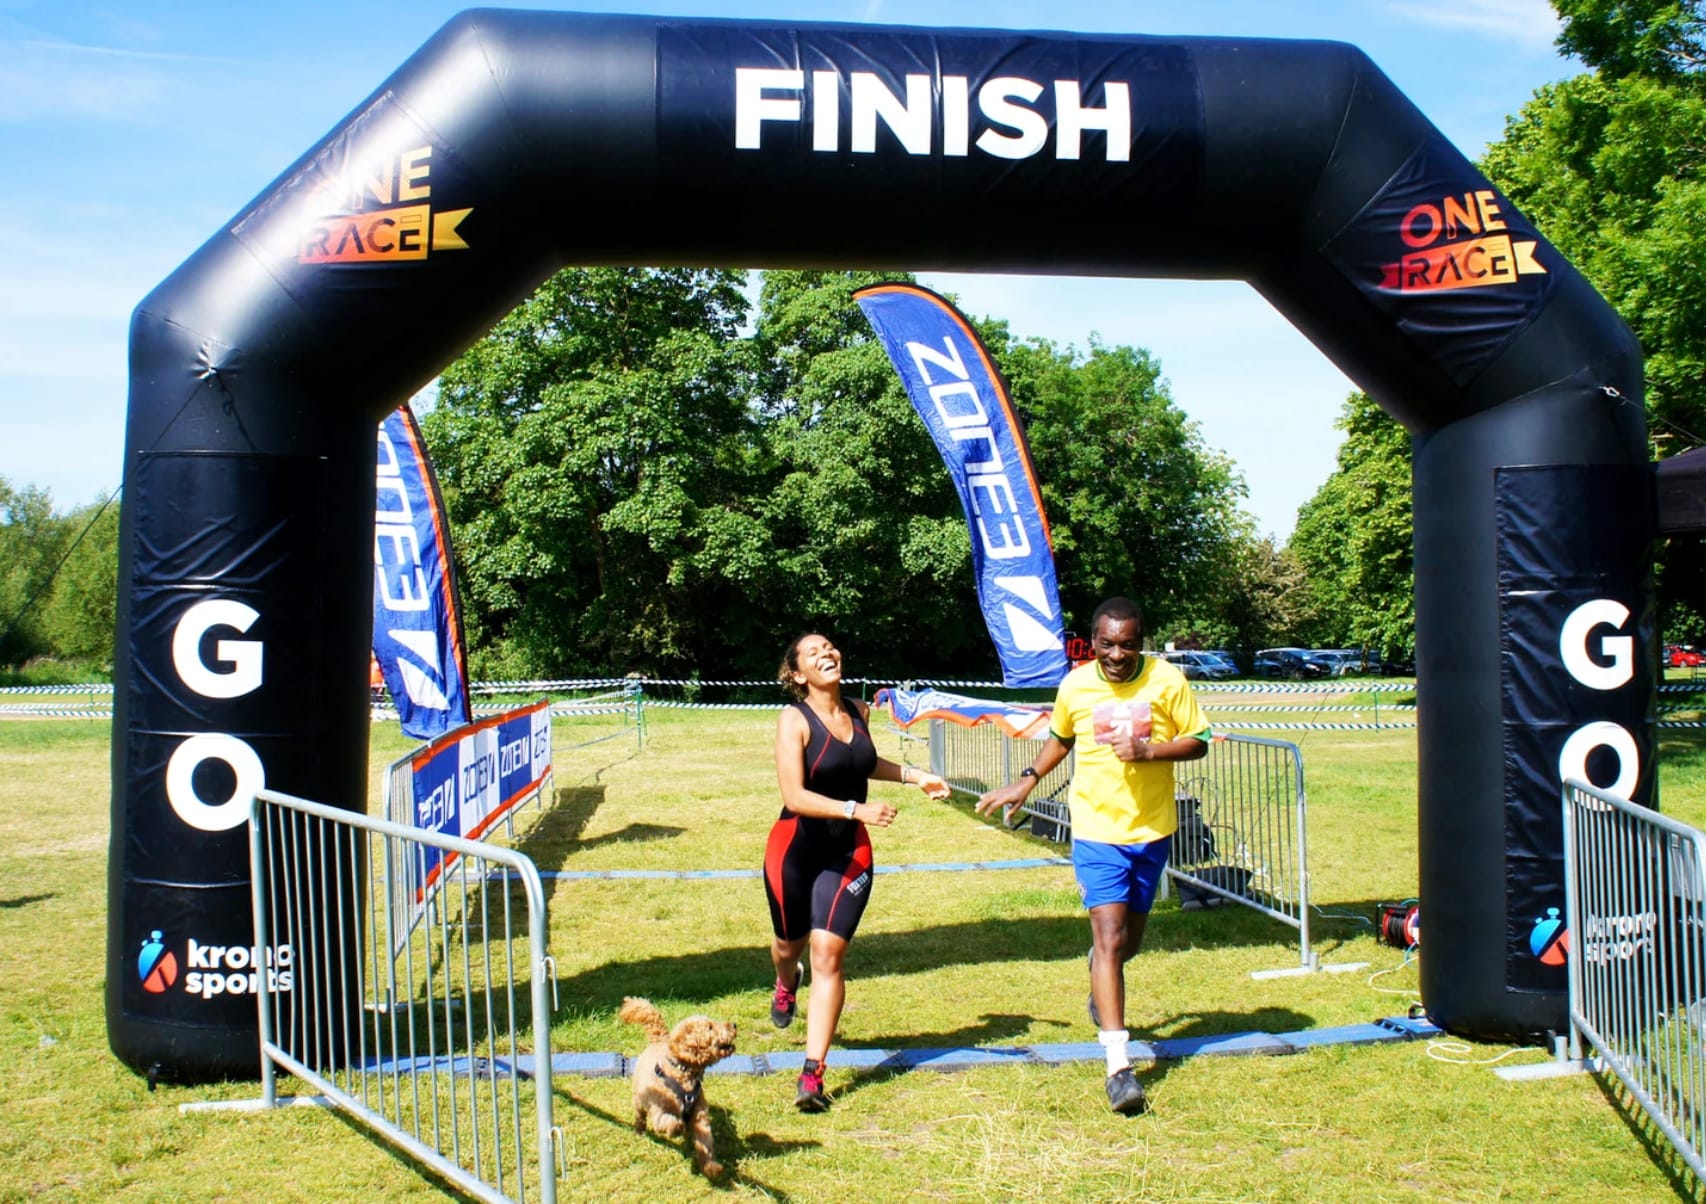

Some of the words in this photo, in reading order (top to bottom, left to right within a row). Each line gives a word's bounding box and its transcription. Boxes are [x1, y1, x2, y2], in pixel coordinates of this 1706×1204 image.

[735, 67, 1131, 162] FINISH
[318, 145, 432, 212] NE
[306, 215, 422, 257] RACE
[1400, 190, 1507, 248] ONE
[1408, 242, 1508, 287] RACE
[374, 422, 430, 611] ONE3
[187, 938, 295, 968] krono
[185, 968, 294, 999] sports
